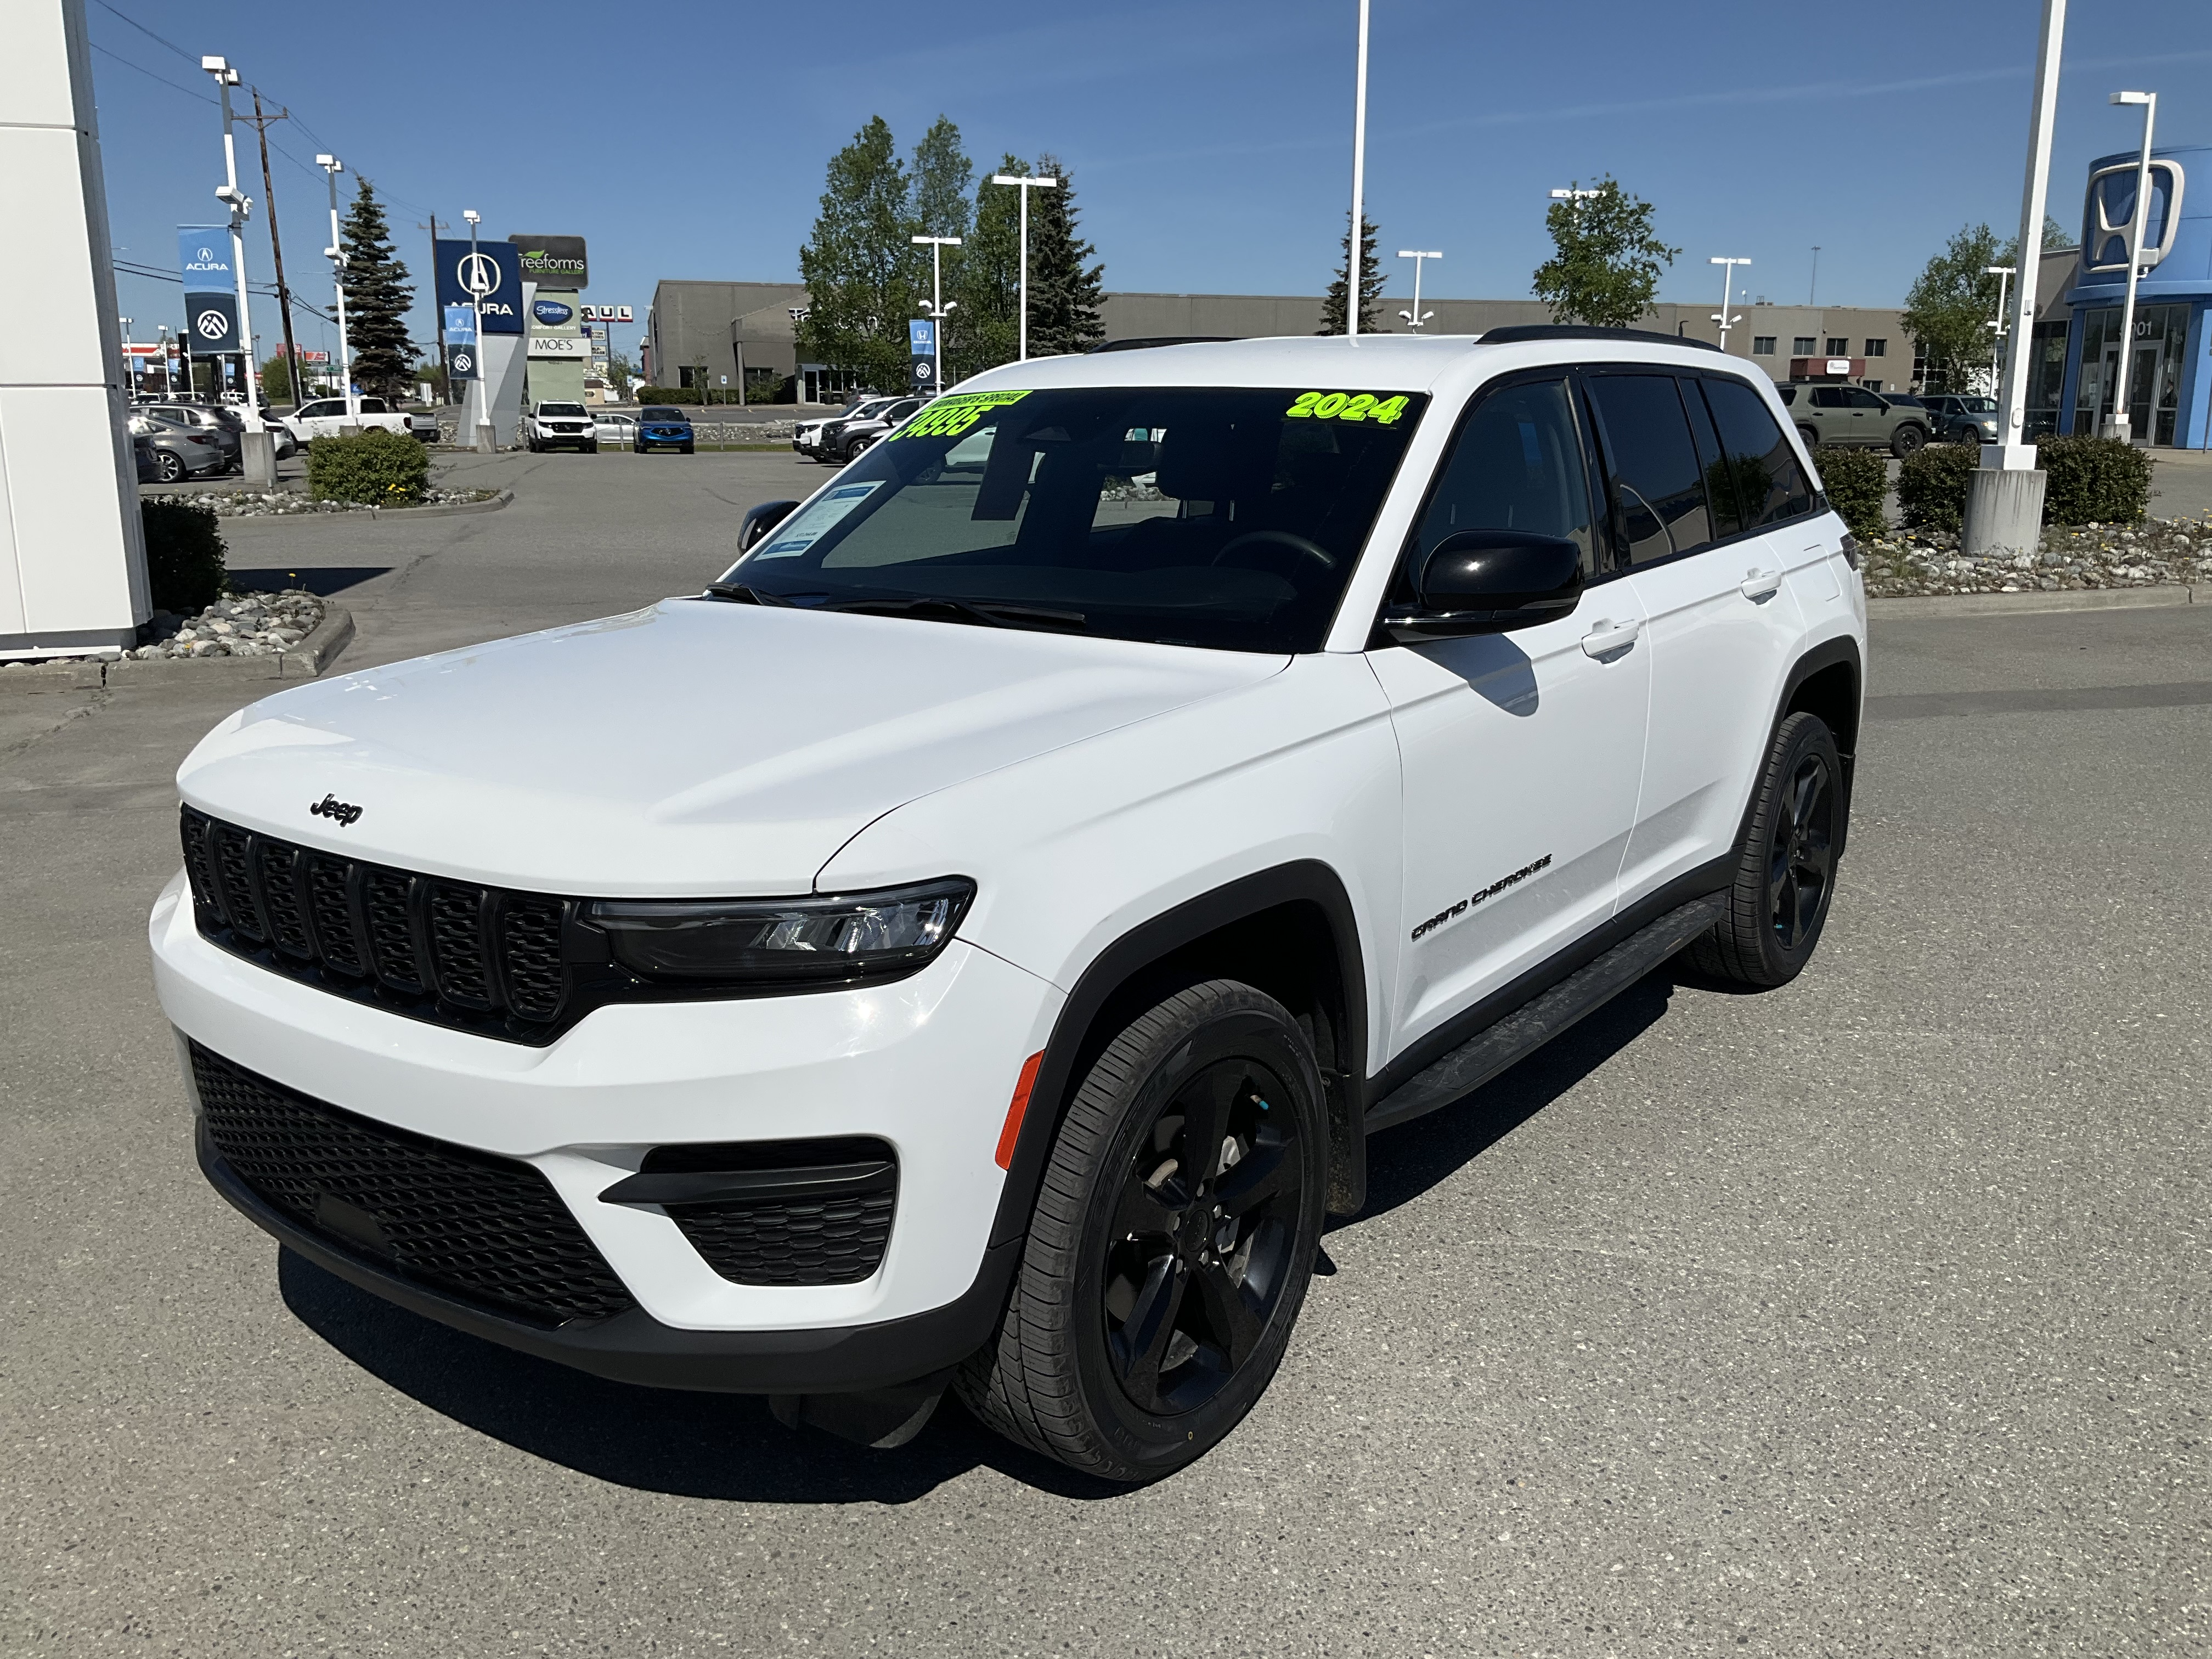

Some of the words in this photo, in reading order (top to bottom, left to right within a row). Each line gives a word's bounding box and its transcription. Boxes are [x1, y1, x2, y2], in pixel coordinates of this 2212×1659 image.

[537, 306, 569, 315] Stressless
[2119, 321, 2152, 336] 01
[535, 338, 573, 350] MOE'S
[1286, 392, 1410, 424] 2024
[310, 793, 363, 828] Jeep
[1412, 899, 1468, 942] GRAND
[1471, 853, 1553, 906] CHEROKEE
